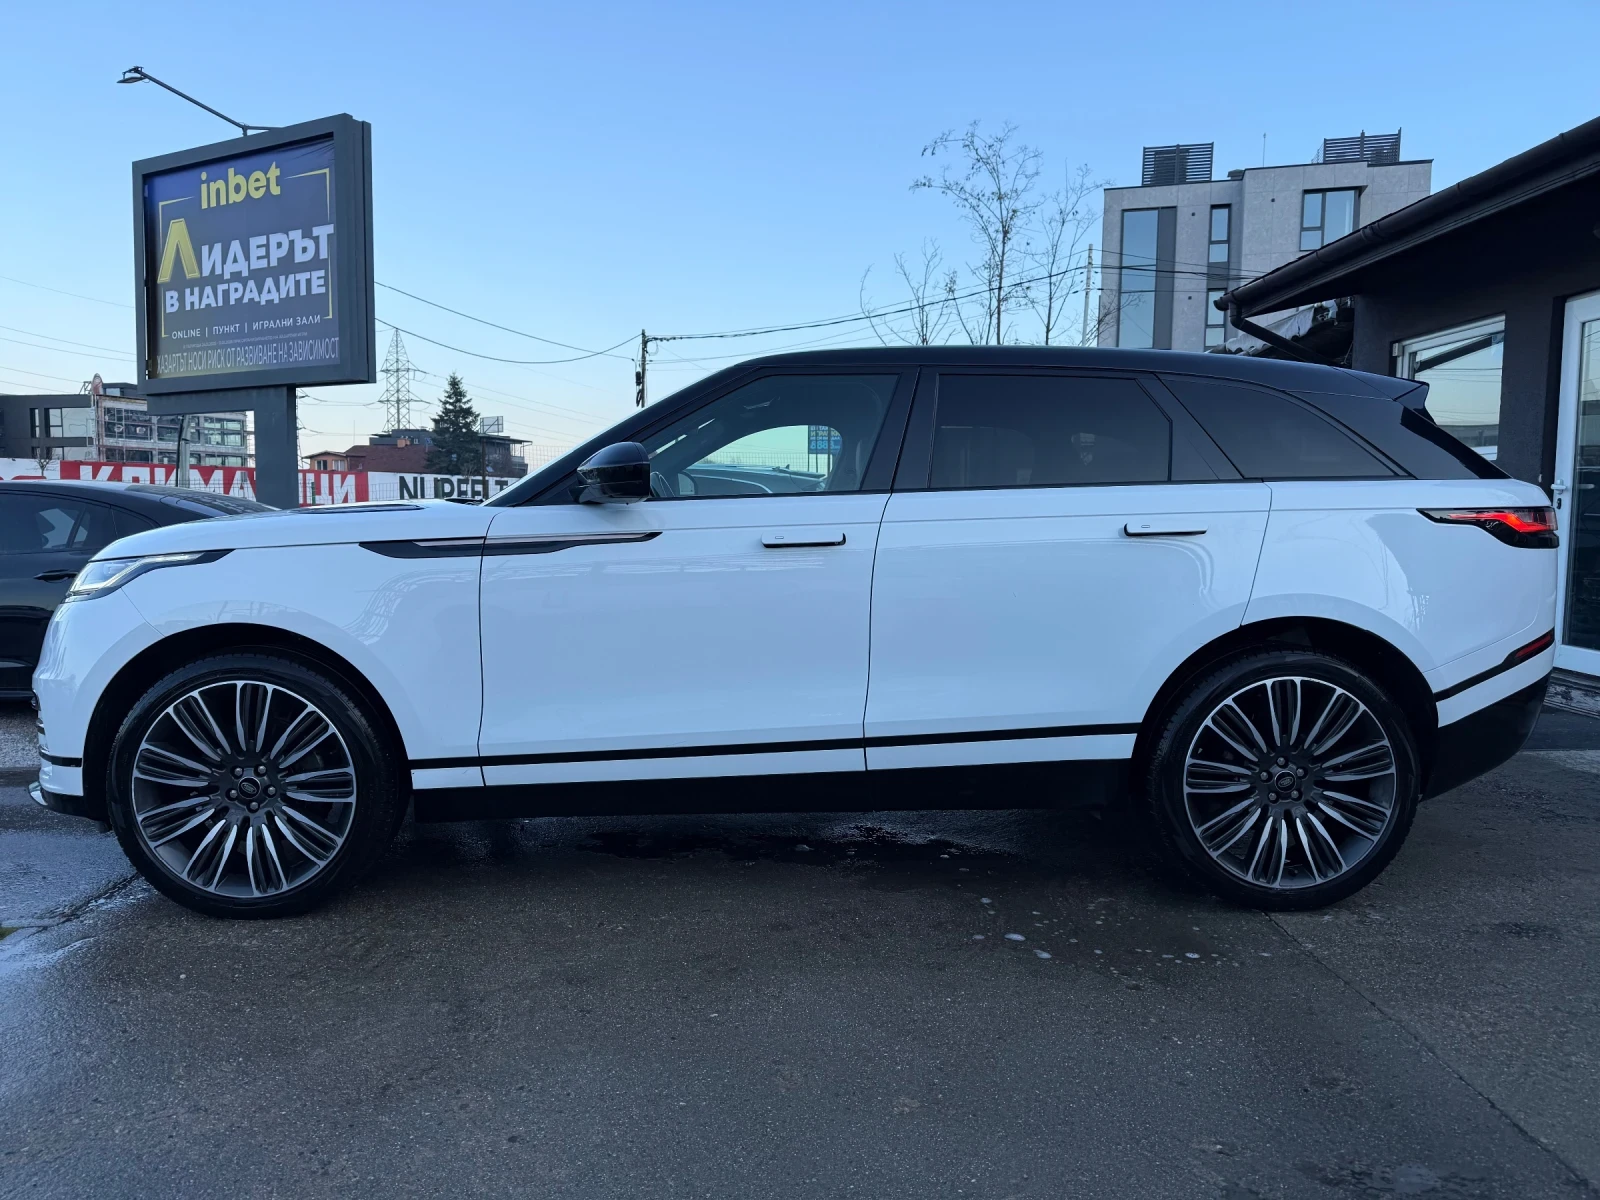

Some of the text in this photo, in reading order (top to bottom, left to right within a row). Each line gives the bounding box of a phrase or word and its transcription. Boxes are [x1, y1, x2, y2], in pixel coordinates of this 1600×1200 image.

[201, 161, 281, 210] inbet
[157, 218, 334, 284] ЛИДЕРЪТ
[165, 270, 326, 314] В НАГРАДИТЕ
[171, 328, 201, 340] ONLINE
[213, 323, 240, 335] ПУНКТ
[252, 317, 293, 330] ИГРАЛНИ
[295, 314, 321, 326] ЗАЛИ
[157, 352, 188, 375] ХАЗАРТЪТ
[188, 350, 207, 371] НОСИ
[207, 348, 226, 369] РИСК
[226, 347, 236, 368] ОТ
[236, 343, 277, 367] РАЗВИВАНЕ
[278, 341, 289, 363] НА
[289, 337, 339, 362] ЗАВИСИМОСТ
